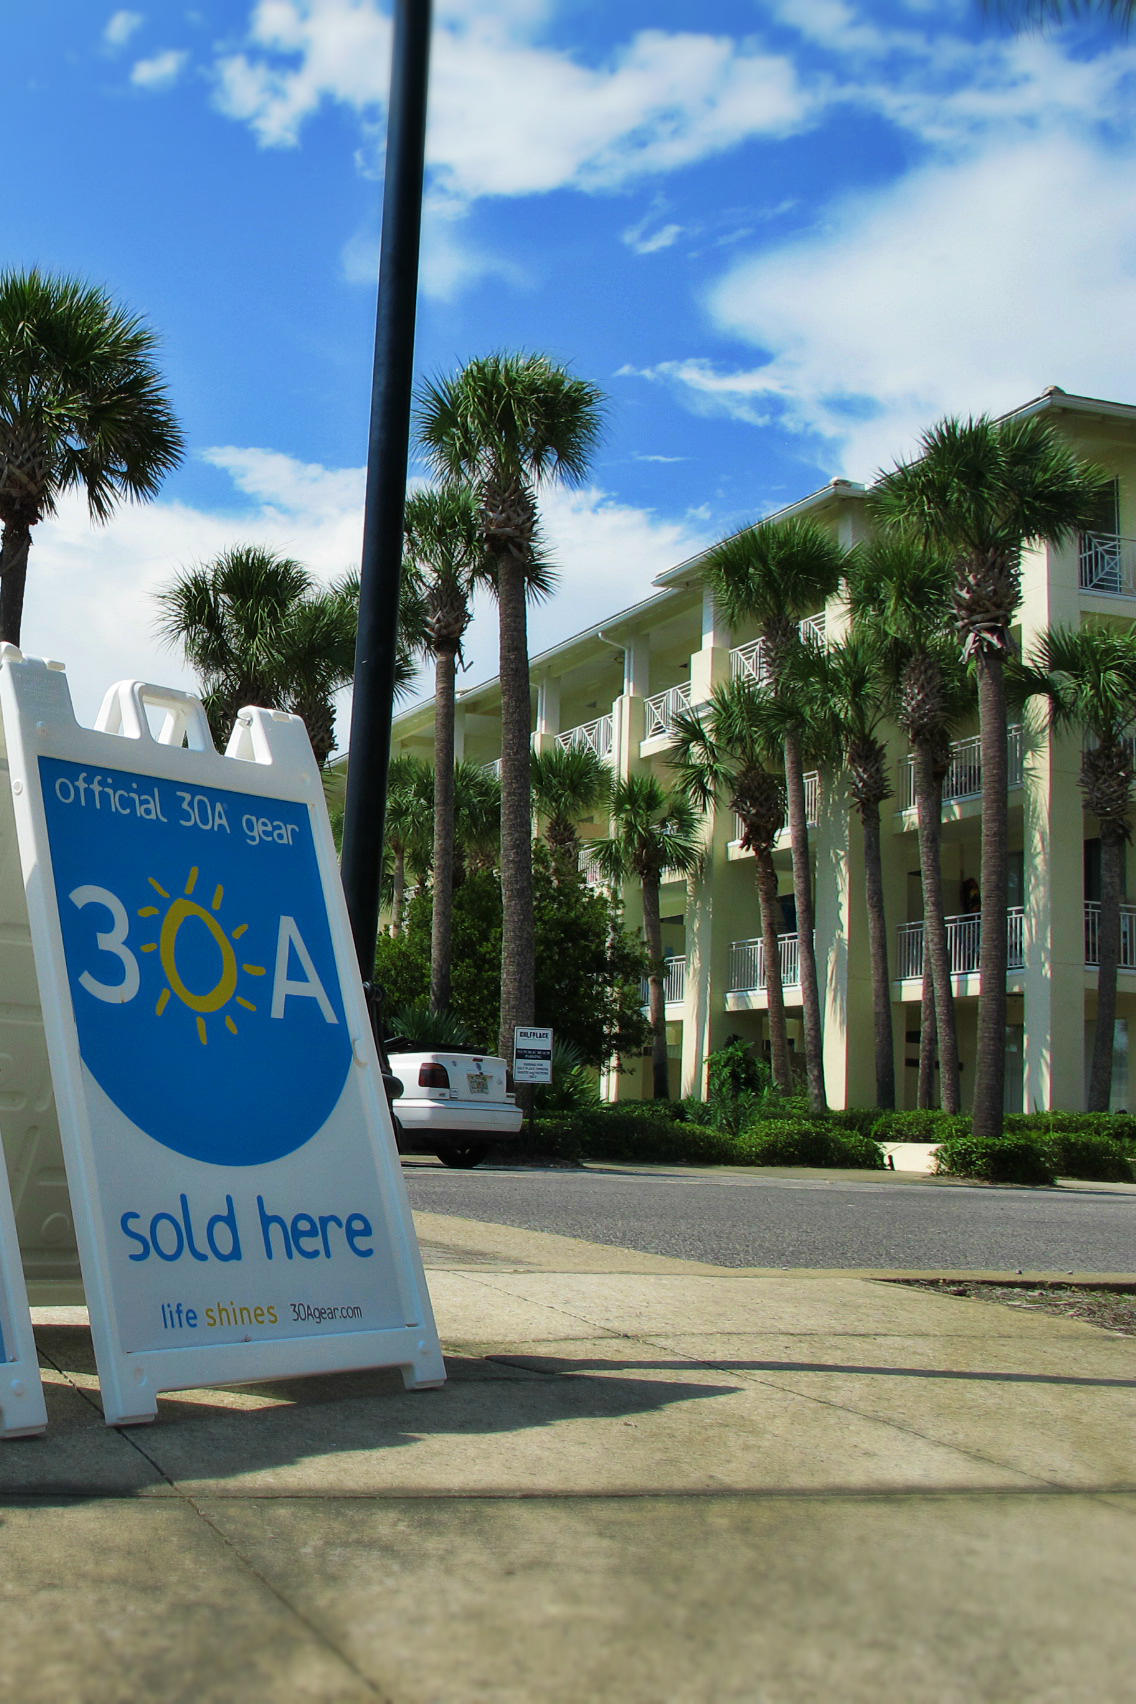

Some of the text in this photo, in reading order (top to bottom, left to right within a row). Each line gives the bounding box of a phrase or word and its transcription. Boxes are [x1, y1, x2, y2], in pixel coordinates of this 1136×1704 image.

[55, 772, 300, 845] official 30A gear
[120, 1193, 375, 1262] sold here
[161, 1301, 363, 1329] life shines 30Agear.com
